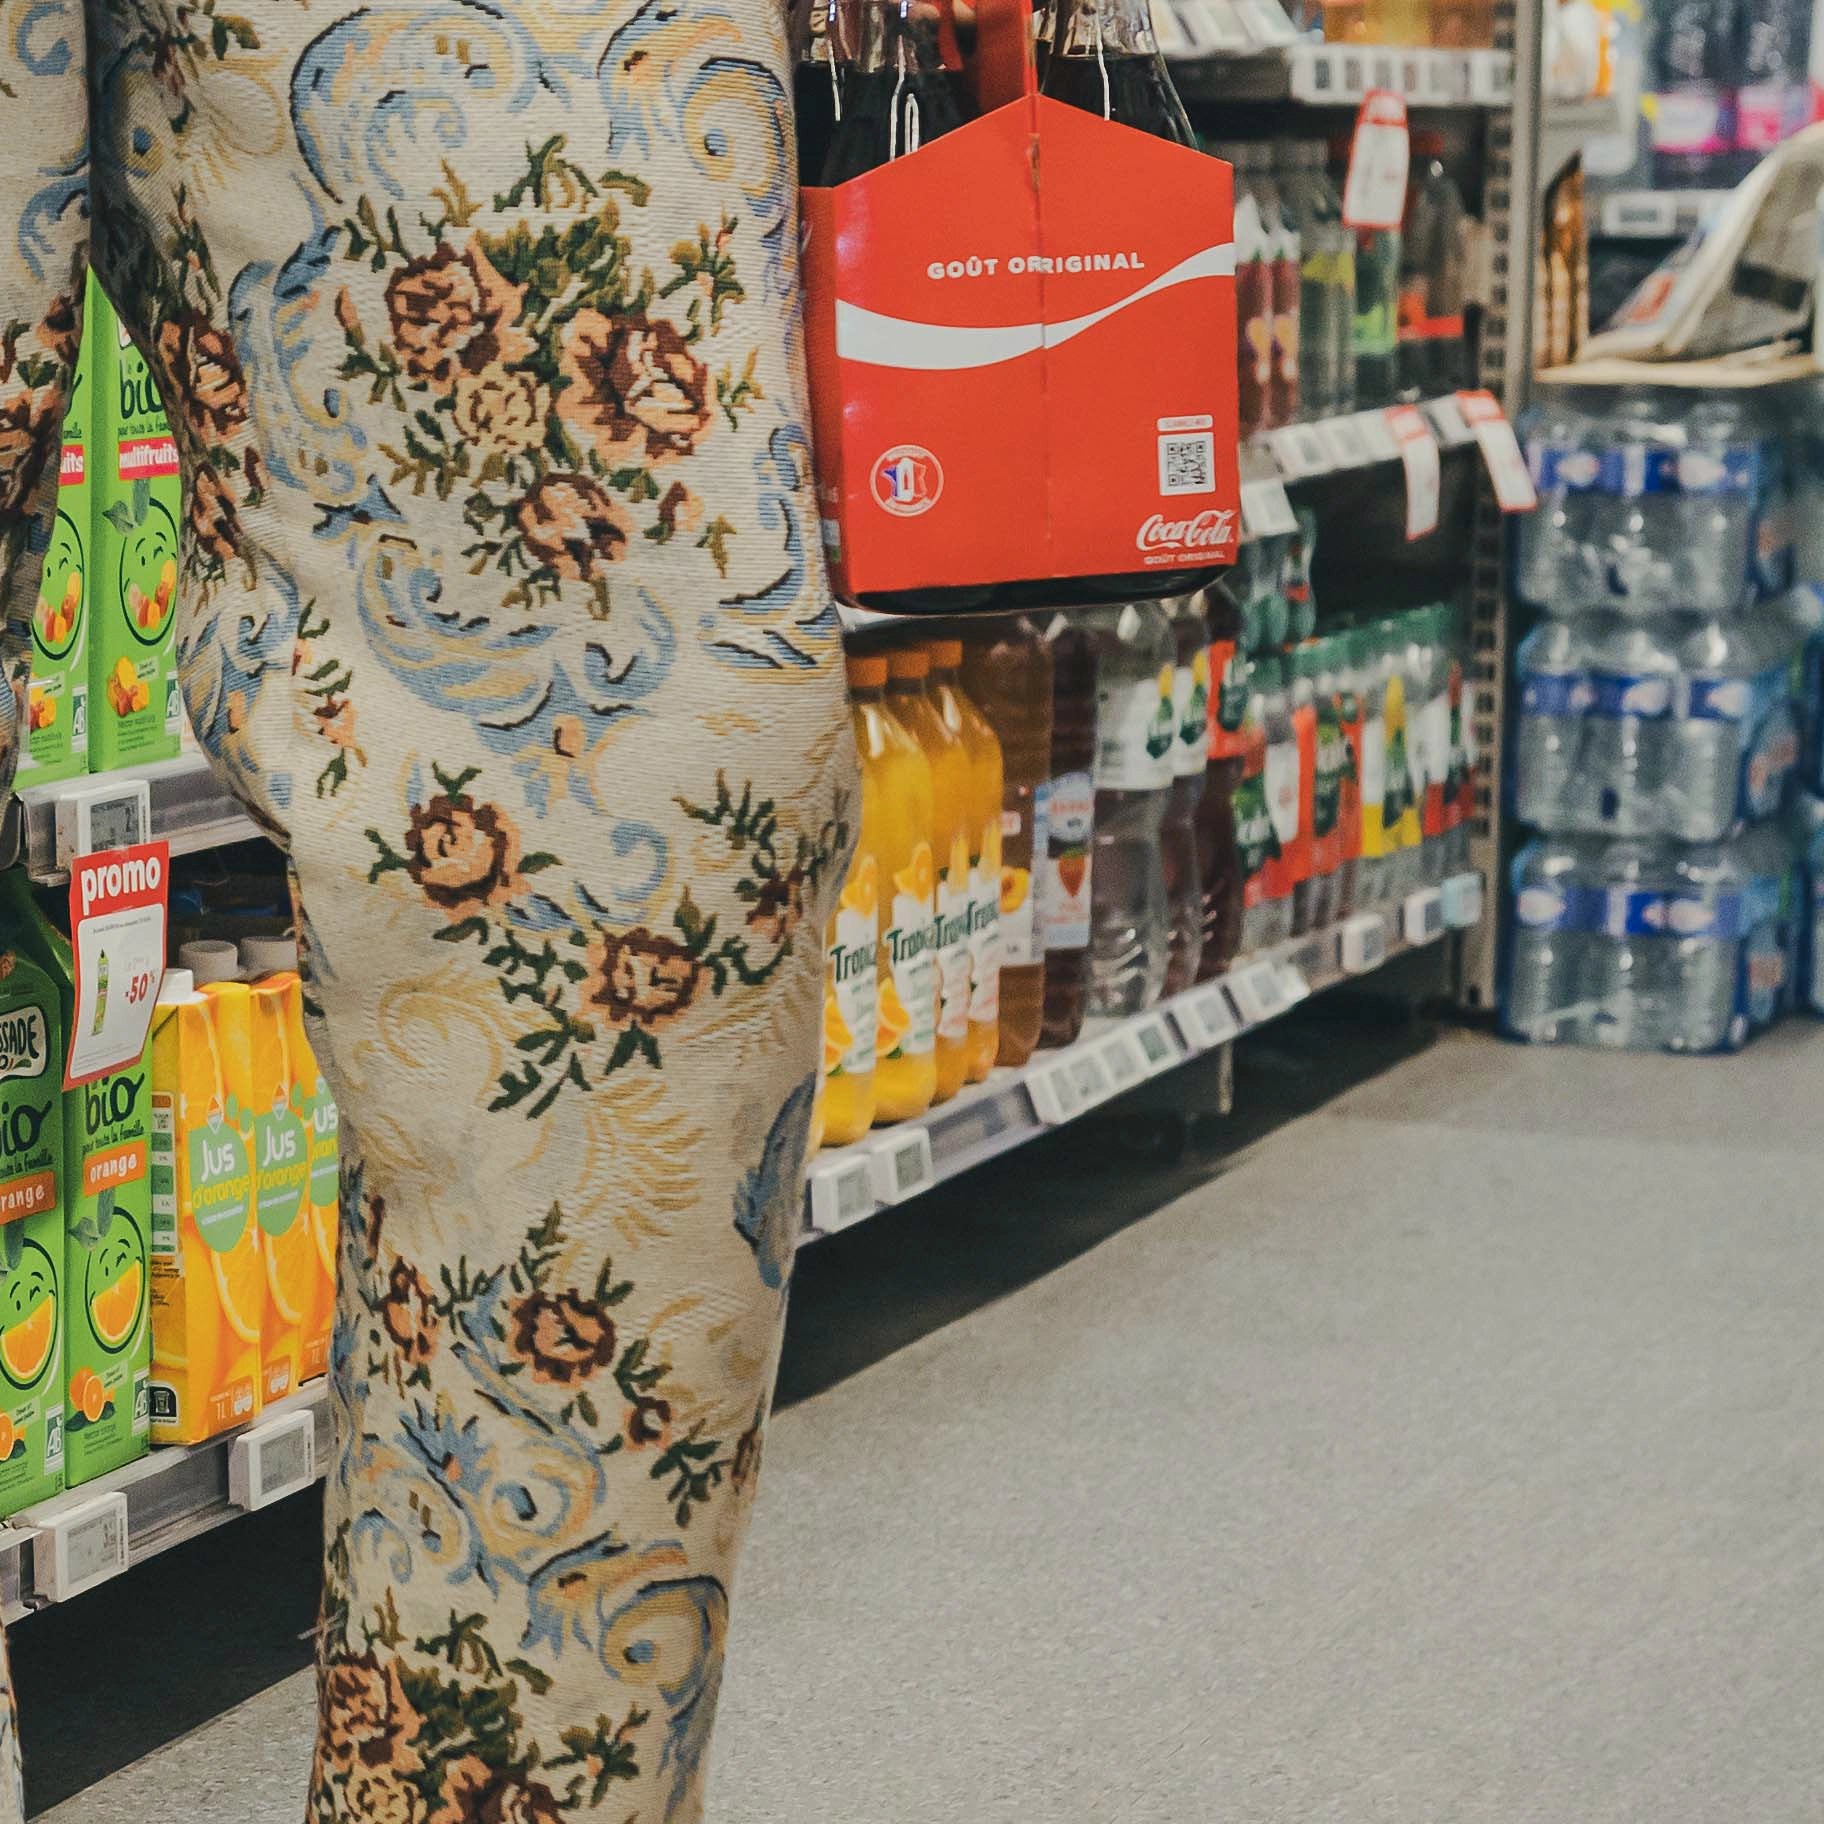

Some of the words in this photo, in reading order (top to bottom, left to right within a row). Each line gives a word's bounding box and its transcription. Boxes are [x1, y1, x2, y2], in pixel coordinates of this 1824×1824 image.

[927, 255, 998, 280] GOÛT
[1007, 252, 1145, 274] ORIGINAL
[1136, 509, 1236, 552] Coca-Cola
[81, 856, 161, 916] promo
[86, 1073, 144, 1135] bio
[314, 1103, 338, 1133] us
[201, 1139, 235, 1182] Jus
[263, 1125, 296, 1167] Jus
[90, 1152, 137, 1184] orange
